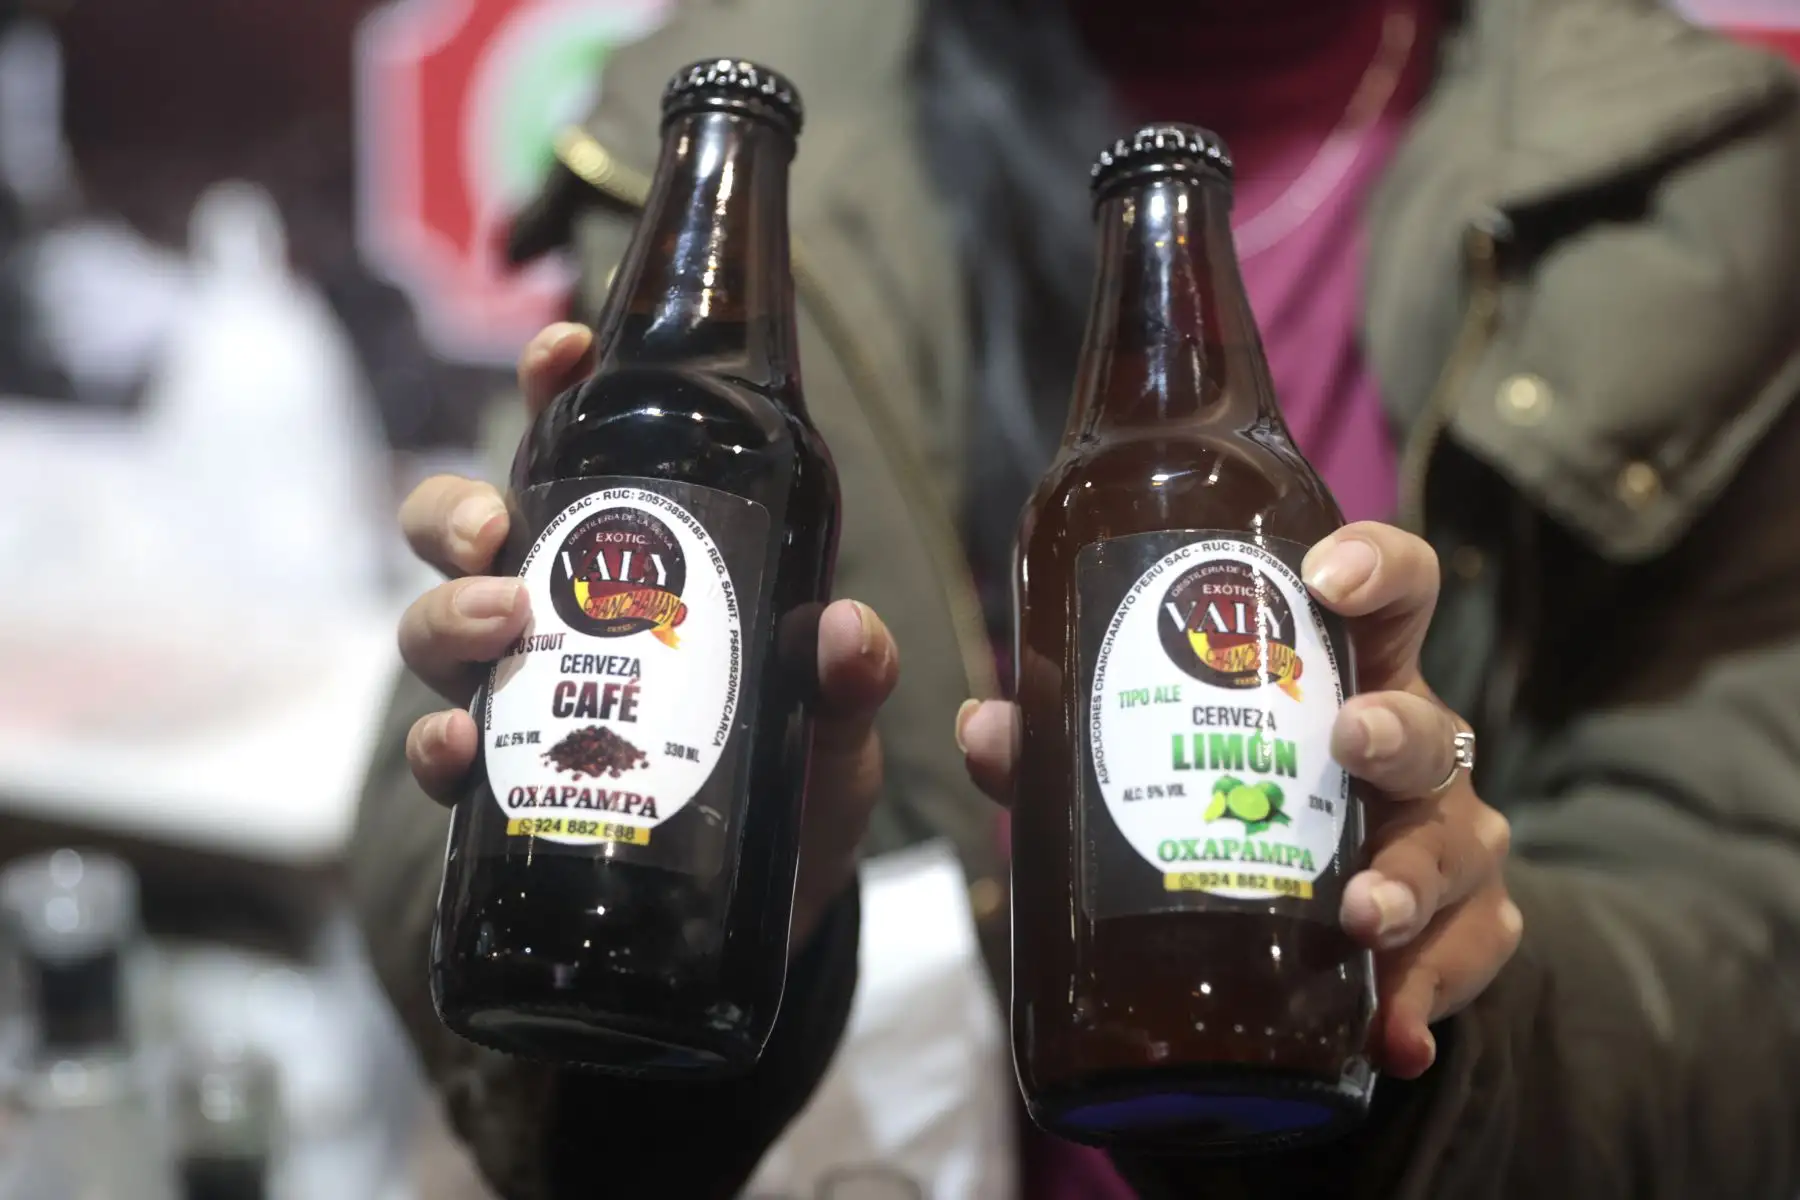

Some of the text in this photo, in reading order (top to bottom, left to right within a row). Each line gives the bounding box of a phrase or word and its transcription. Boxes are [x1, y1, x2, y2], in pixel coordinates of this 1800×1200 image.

[541, 512, 567, 542] PERU
[569, 497, 592, 515] SAC
[603, 489, 635, 501] RUC:
[707, 548, 723, 578] REG.
[721, 580, 738, 623] SANIT.
[1166, 548, 1191, 567] SAC
[1202, 541, 1236, 552] RUC:
[561, 550, 680, 587] VALY
[1134, 564, 1164, 594] PERU
[1165, 600, 1289, 640] VALY
[526, 633, 566, 653] STOUT
[1095, 594, 1136, 691] CHANCHAMAYO
[560, 653, 642, 678] CERVEZA
[552, 676, 642, 723] CAFÉ
[1117, 685, 1181, 709] TIPO ALE
[1192, 705, 1277, 731] CERVEZA
[664, 741, 701, 763] 330 ML
[1091, 694, 1110, 785] AGROLICORES
[1172, 728, 1298, 778] LIMÓN
[507, 785, 659, 819] OXAPAMPA
[534, 818, 561, 832] 924
[567, 820, 599, 836] 882
[1157, 838, 1316, 873] OXAPAMPA
